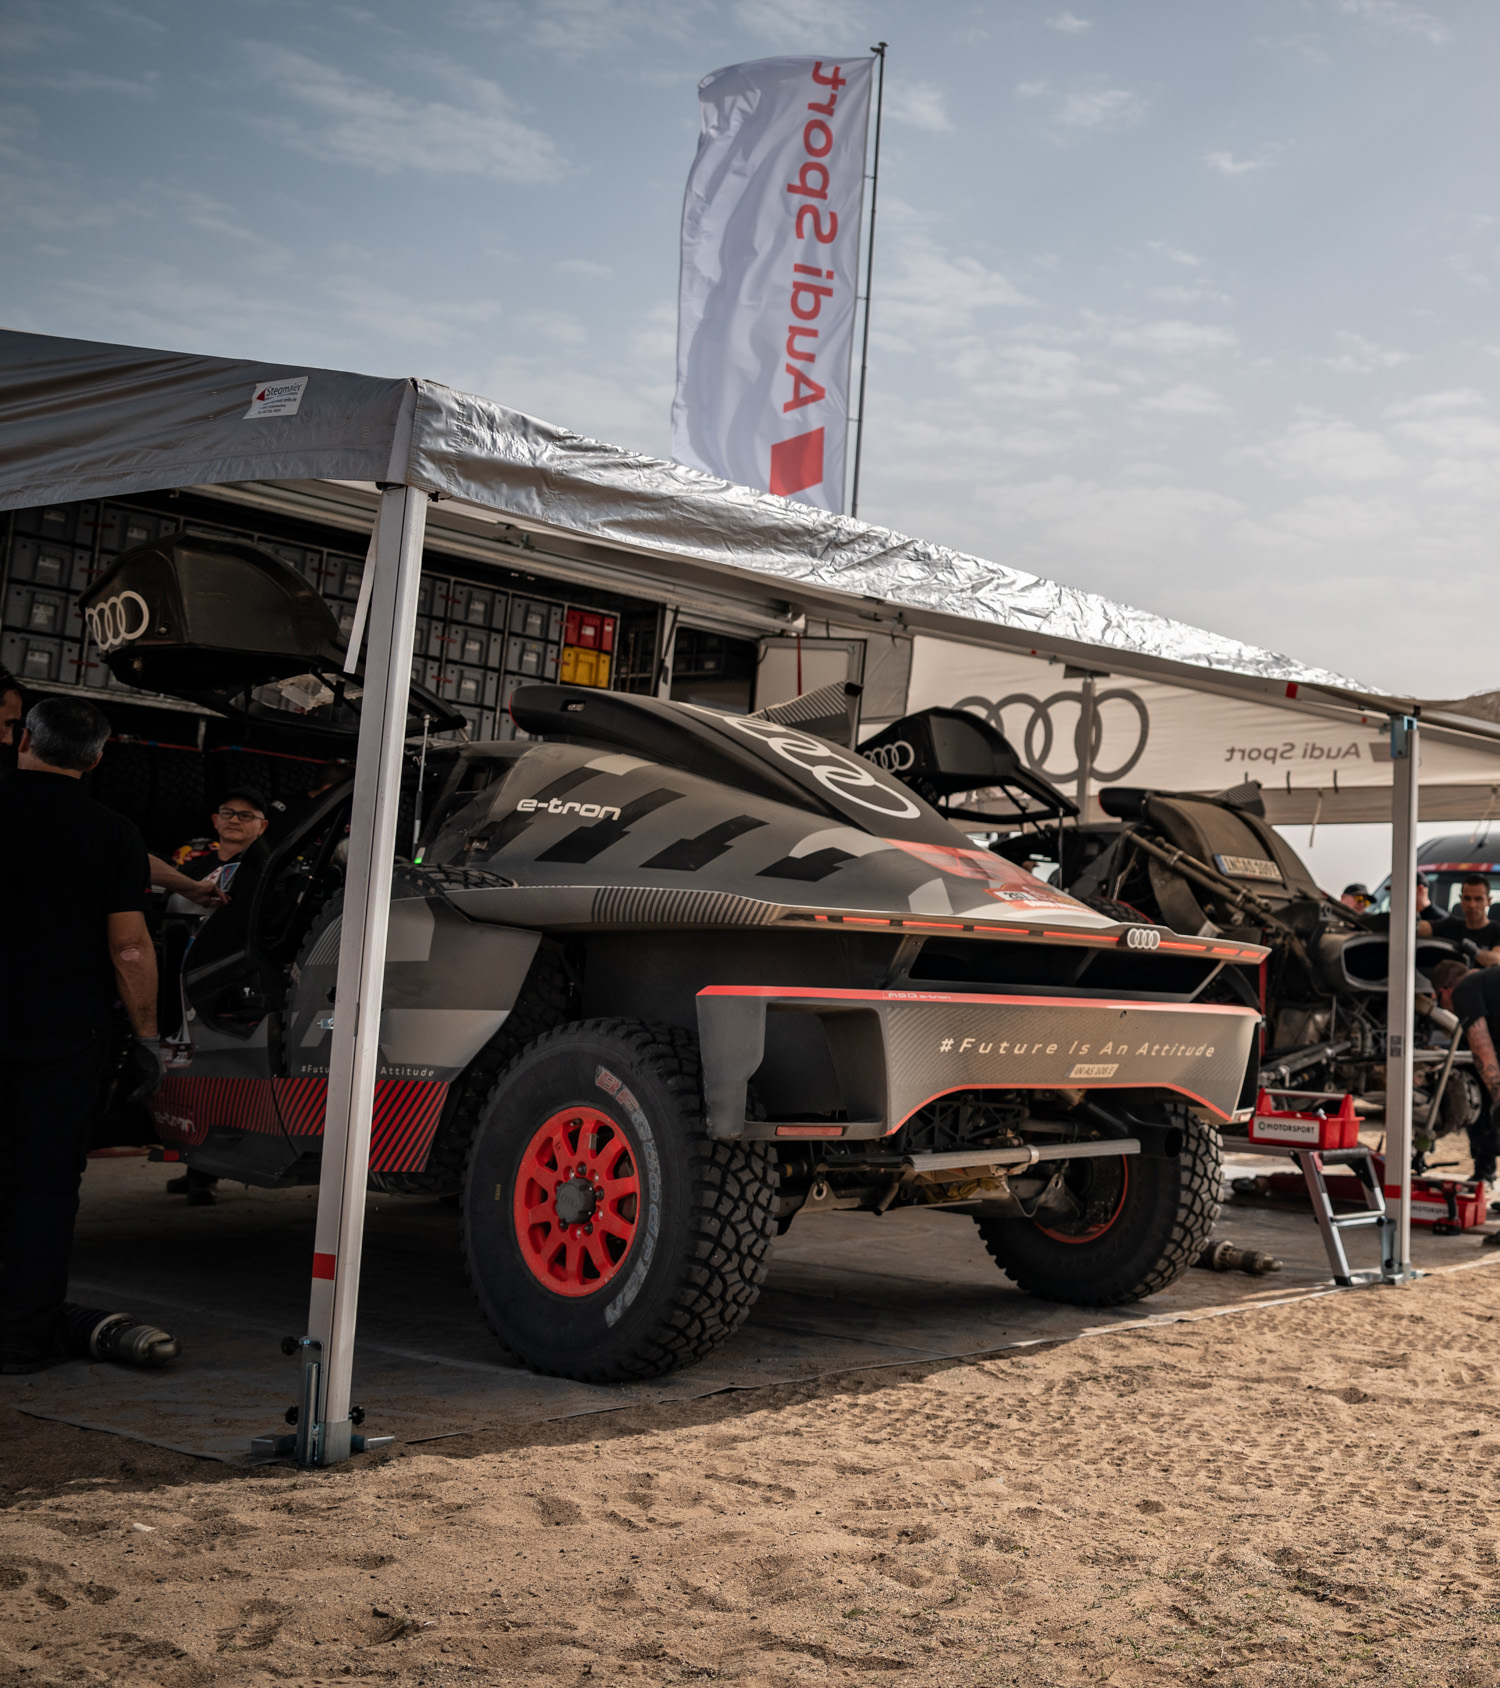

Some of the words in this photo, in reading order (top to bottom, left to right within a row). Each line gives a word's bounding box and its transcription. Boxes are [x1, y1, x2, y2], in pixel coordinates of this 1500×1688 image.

[516, 798, 622, 821] e-tron
[940, 1038, 1058, 1055] #Future
[1069, 1040, 1091, 1056] Is
[1100, 1041, 1129, 1056] An
[1136, 1042, 1215, 1058] Attitude
[301, 1064, 331, 1074] #Futu
[380, 1066, 435, 1077] Attitude
[1267, 1123, 1315, 1134] MOTORSPORT
